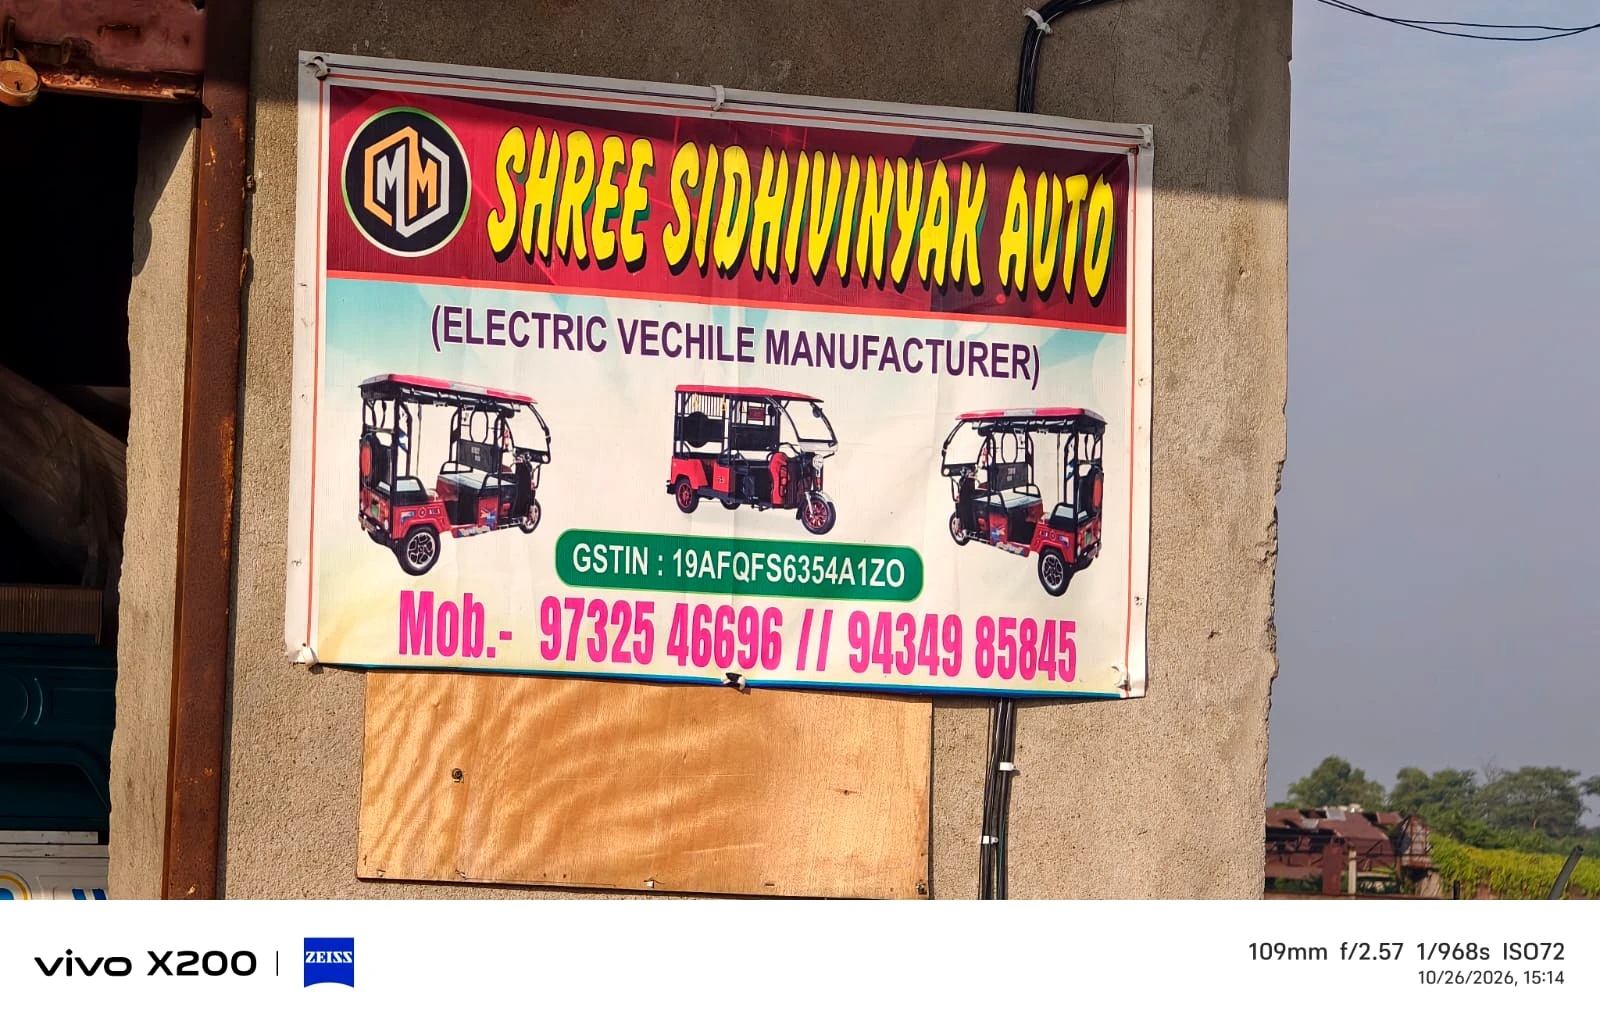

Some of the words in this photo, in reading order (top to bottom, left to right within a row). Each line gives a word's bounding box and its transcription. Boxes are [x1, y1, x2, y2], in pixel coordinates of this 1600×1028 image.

[486, 126, 655, 263] SHREE
[661, 141, 987, 287] SIDHIVINYAK
[997, 167, 1115, 299] AUTO
[431, 305, 607, 353] (ELECTRIC
[617, 318, 755, 363] VECHILE
[766, 328, 1040, 390] MANUFACTURER)
[573, 543, 648, 575] GSTIN
[399, 590, 513, 660] Mob.-
[539, 595, 655, 665] 97325
[666, 602, 783, 671] 46696
[796, 608, 833, 672] //
[847, 610, 963, 678] 94349
[974, 615, 1077, 683] 85845
